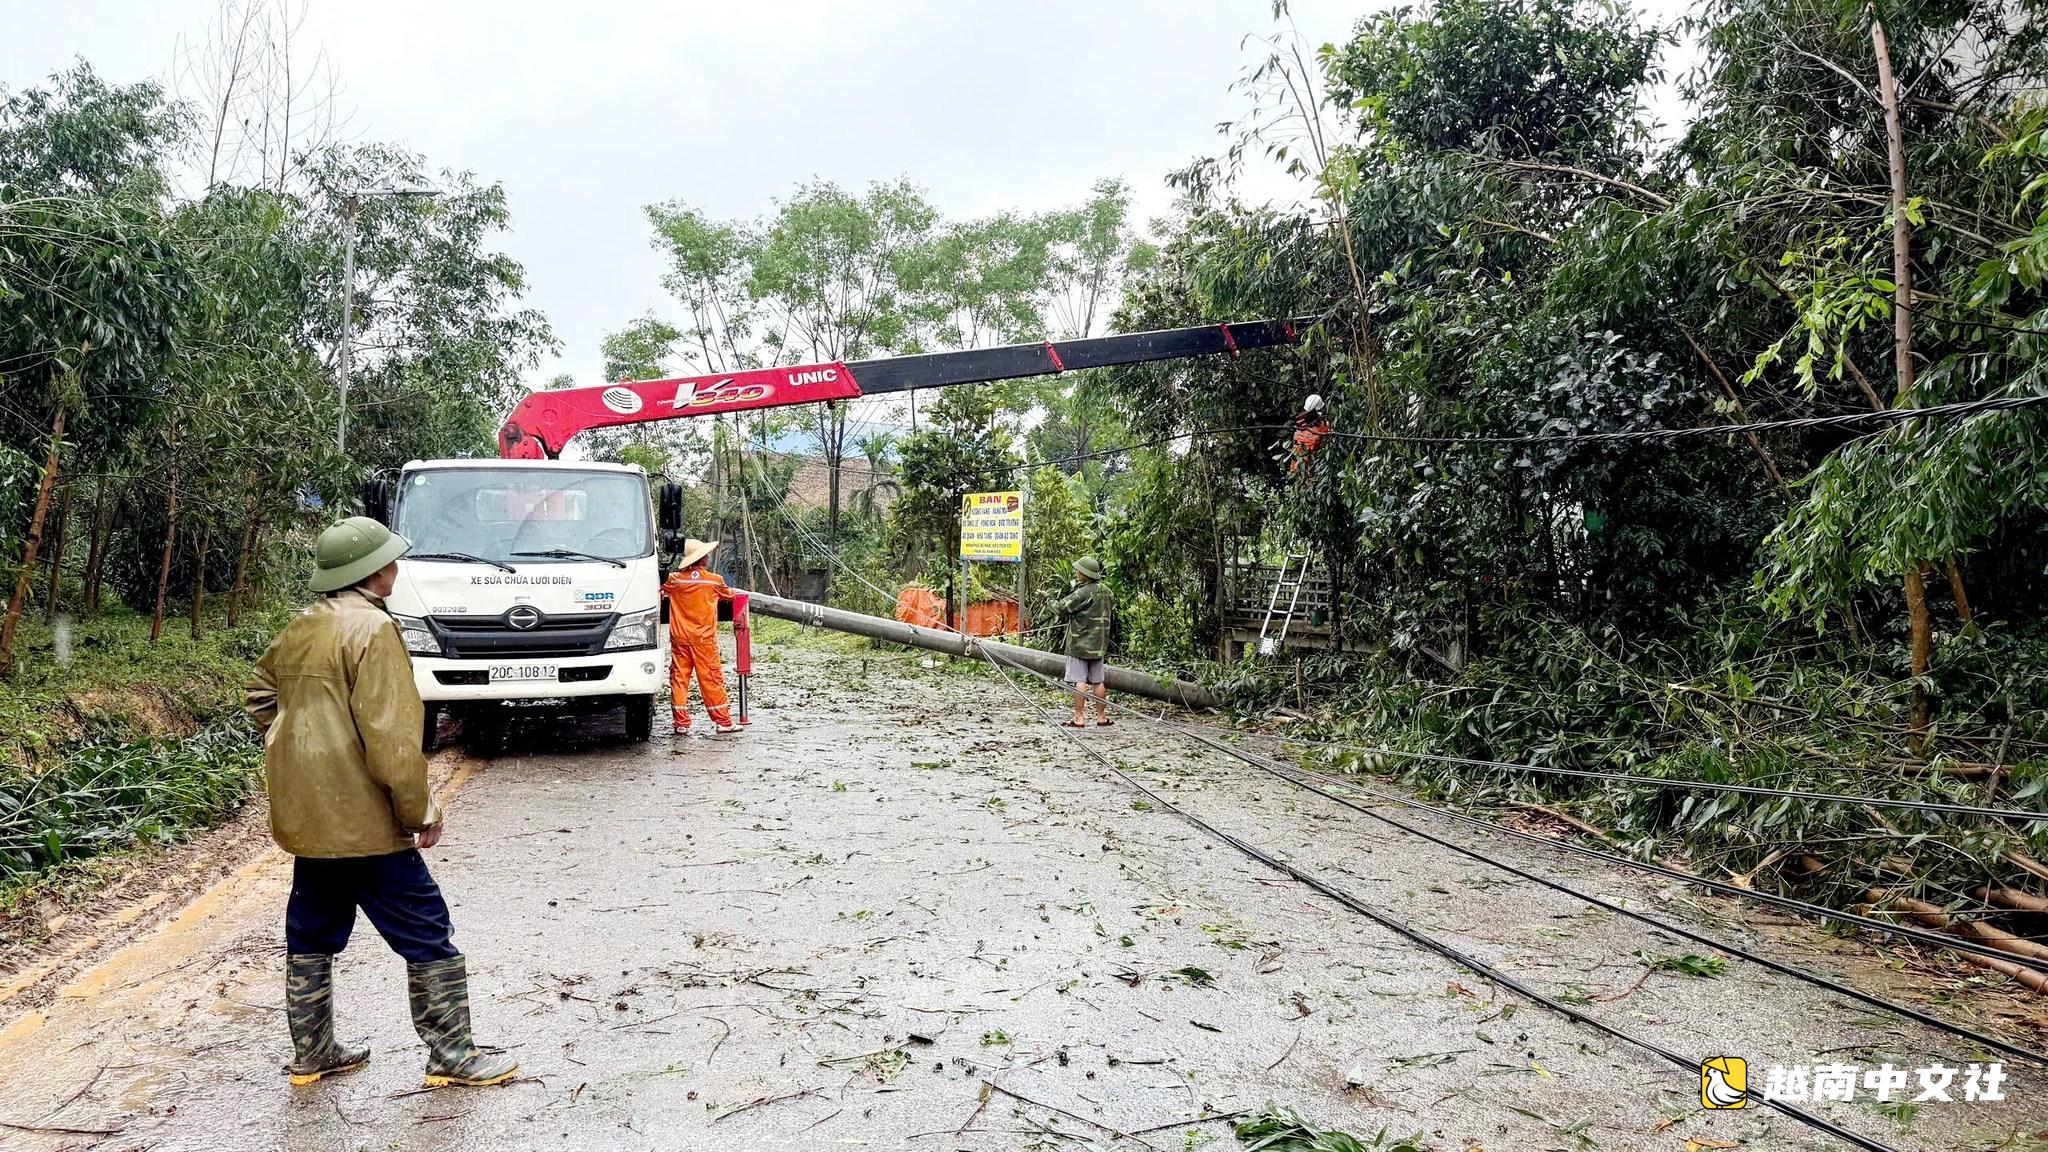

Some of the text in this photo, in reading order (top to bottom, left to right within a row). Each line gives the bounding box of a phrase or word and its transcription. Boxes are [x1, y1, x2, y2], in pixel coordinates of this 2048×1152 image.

[788, 368, 838, 387] UNIC
[471, 576, 481, 585] XE
[584, 592, 615, 601] QDR
[583, 603, 612, 611] 300
